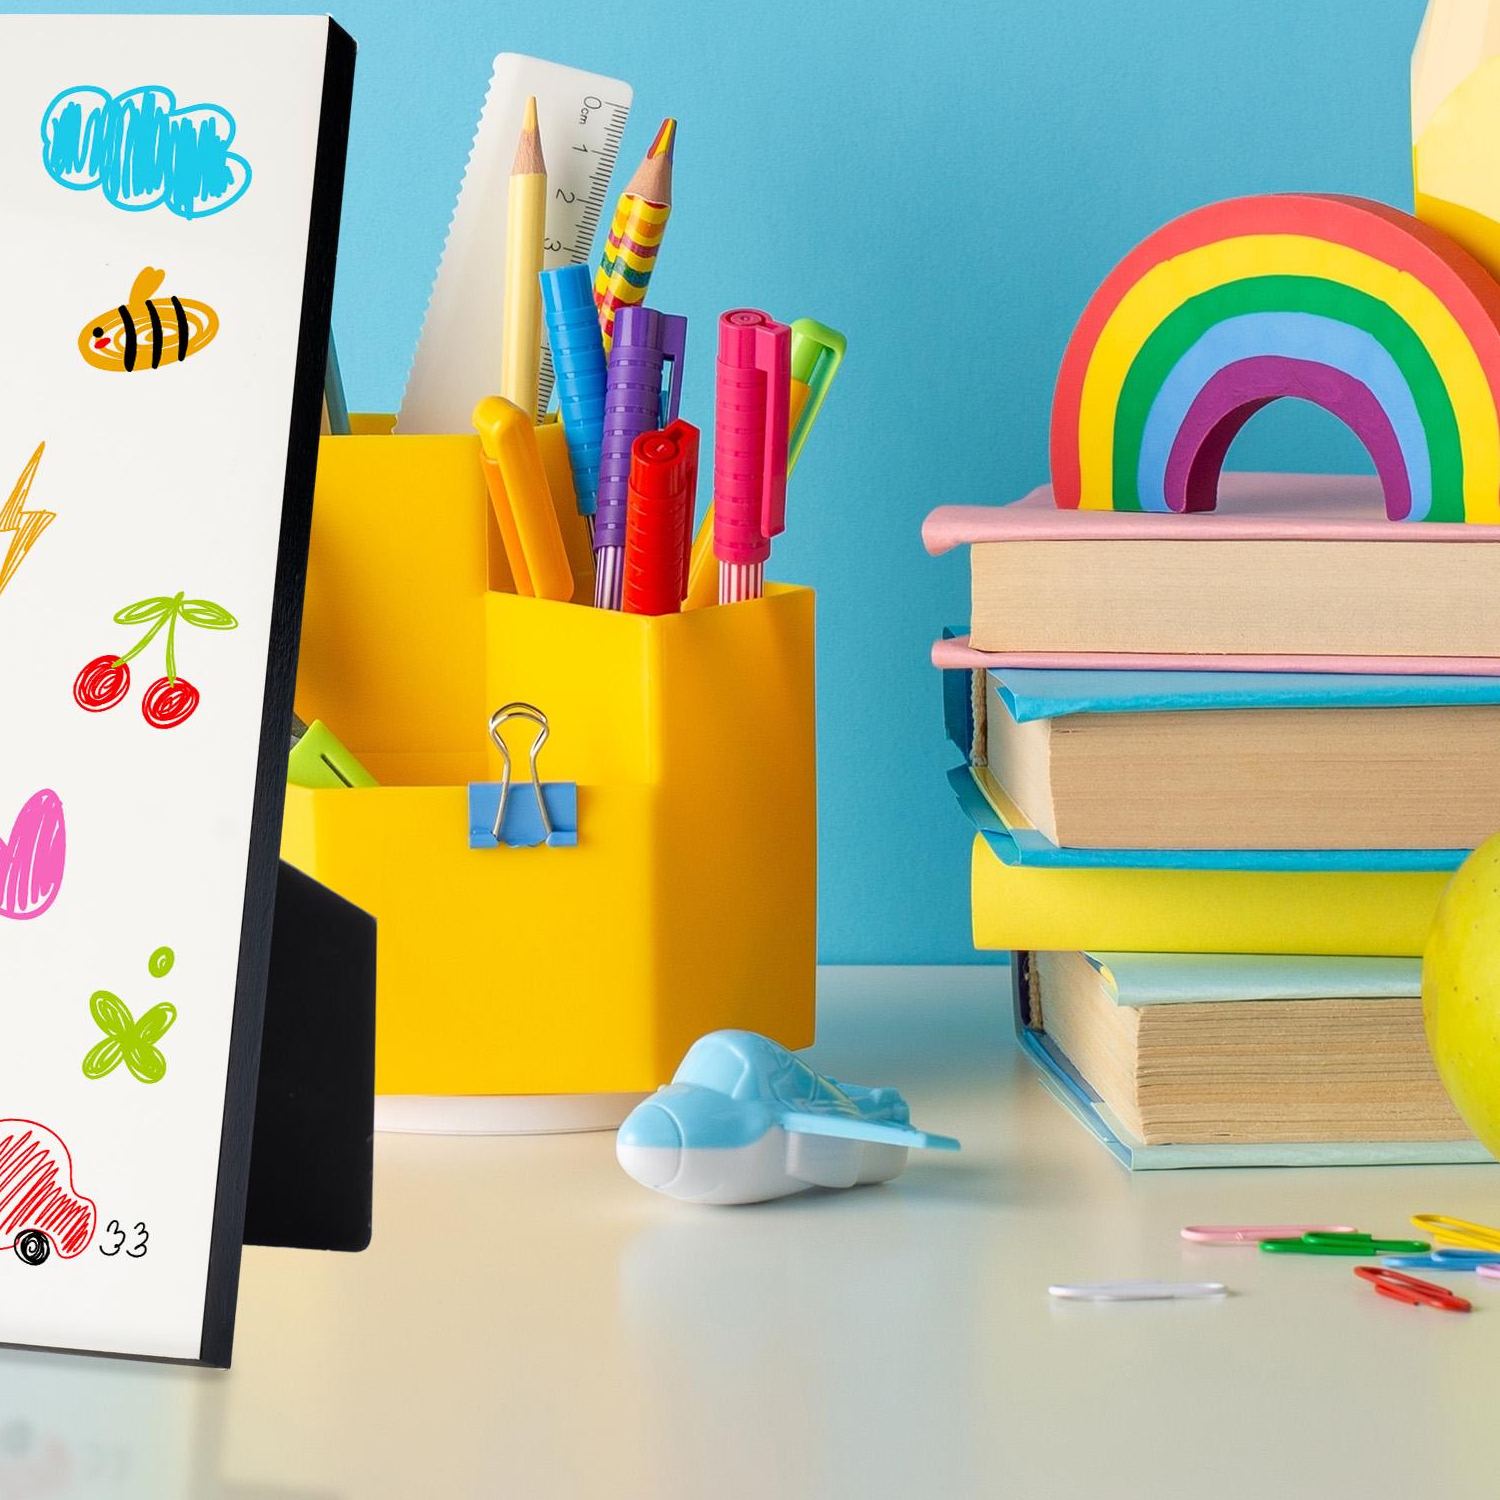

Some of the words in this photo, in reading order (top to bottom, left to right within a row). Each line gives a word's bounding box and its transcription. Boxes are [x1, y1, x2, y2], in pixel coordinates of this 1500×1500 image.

[571, 143, 589, 154] 1
[555, 187, 576, 204] 2
[544, 237, 562, 253] 3
